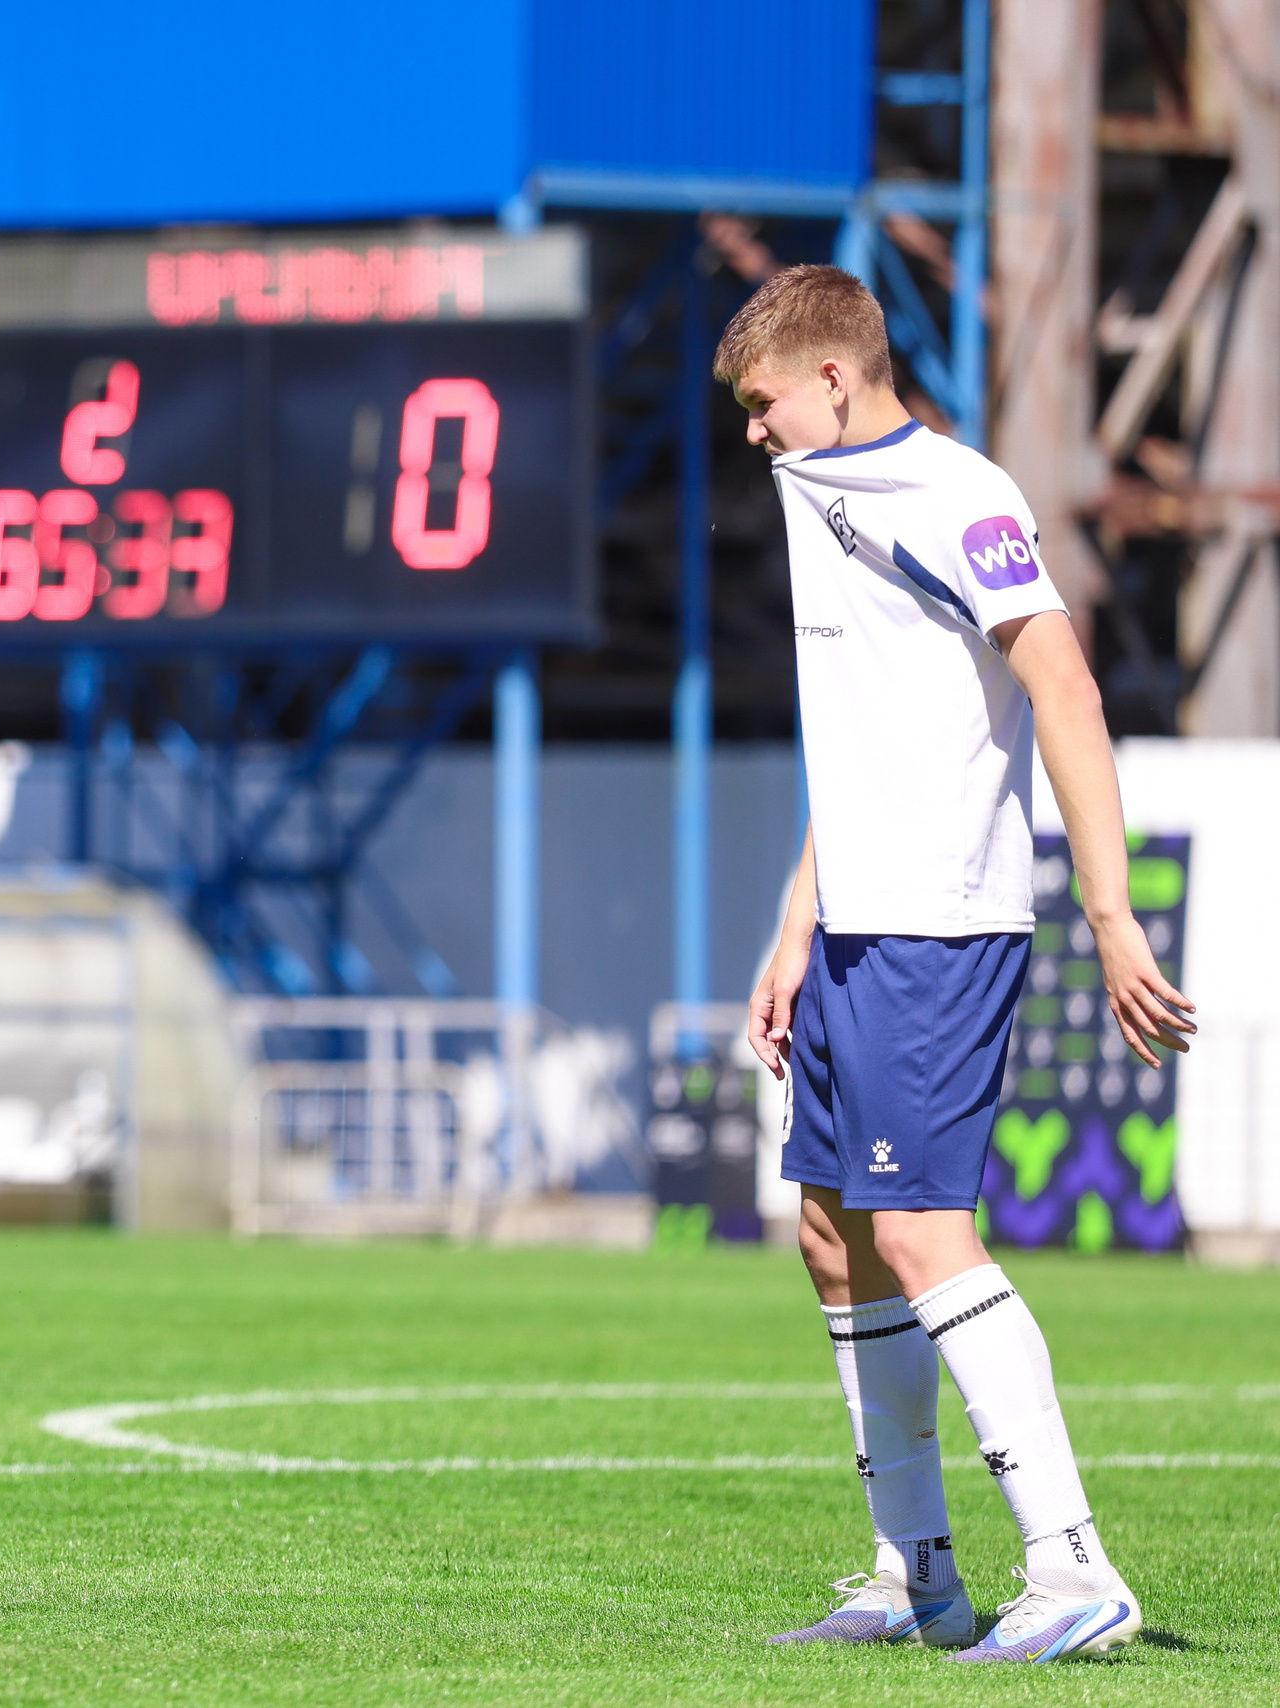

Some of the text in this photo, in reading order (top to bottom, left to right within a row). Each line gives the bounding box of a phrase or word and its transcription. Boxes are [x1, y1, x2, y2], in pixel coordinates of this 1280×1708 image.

[392, 378, 500, 569] 0
[970, 530, 1030, 573] wb
[868, 1163, 900, 1173] KELME
[916, 1539, 930, 1584] ESIGN
[1065, 1528, 1089, 1564] CKS
